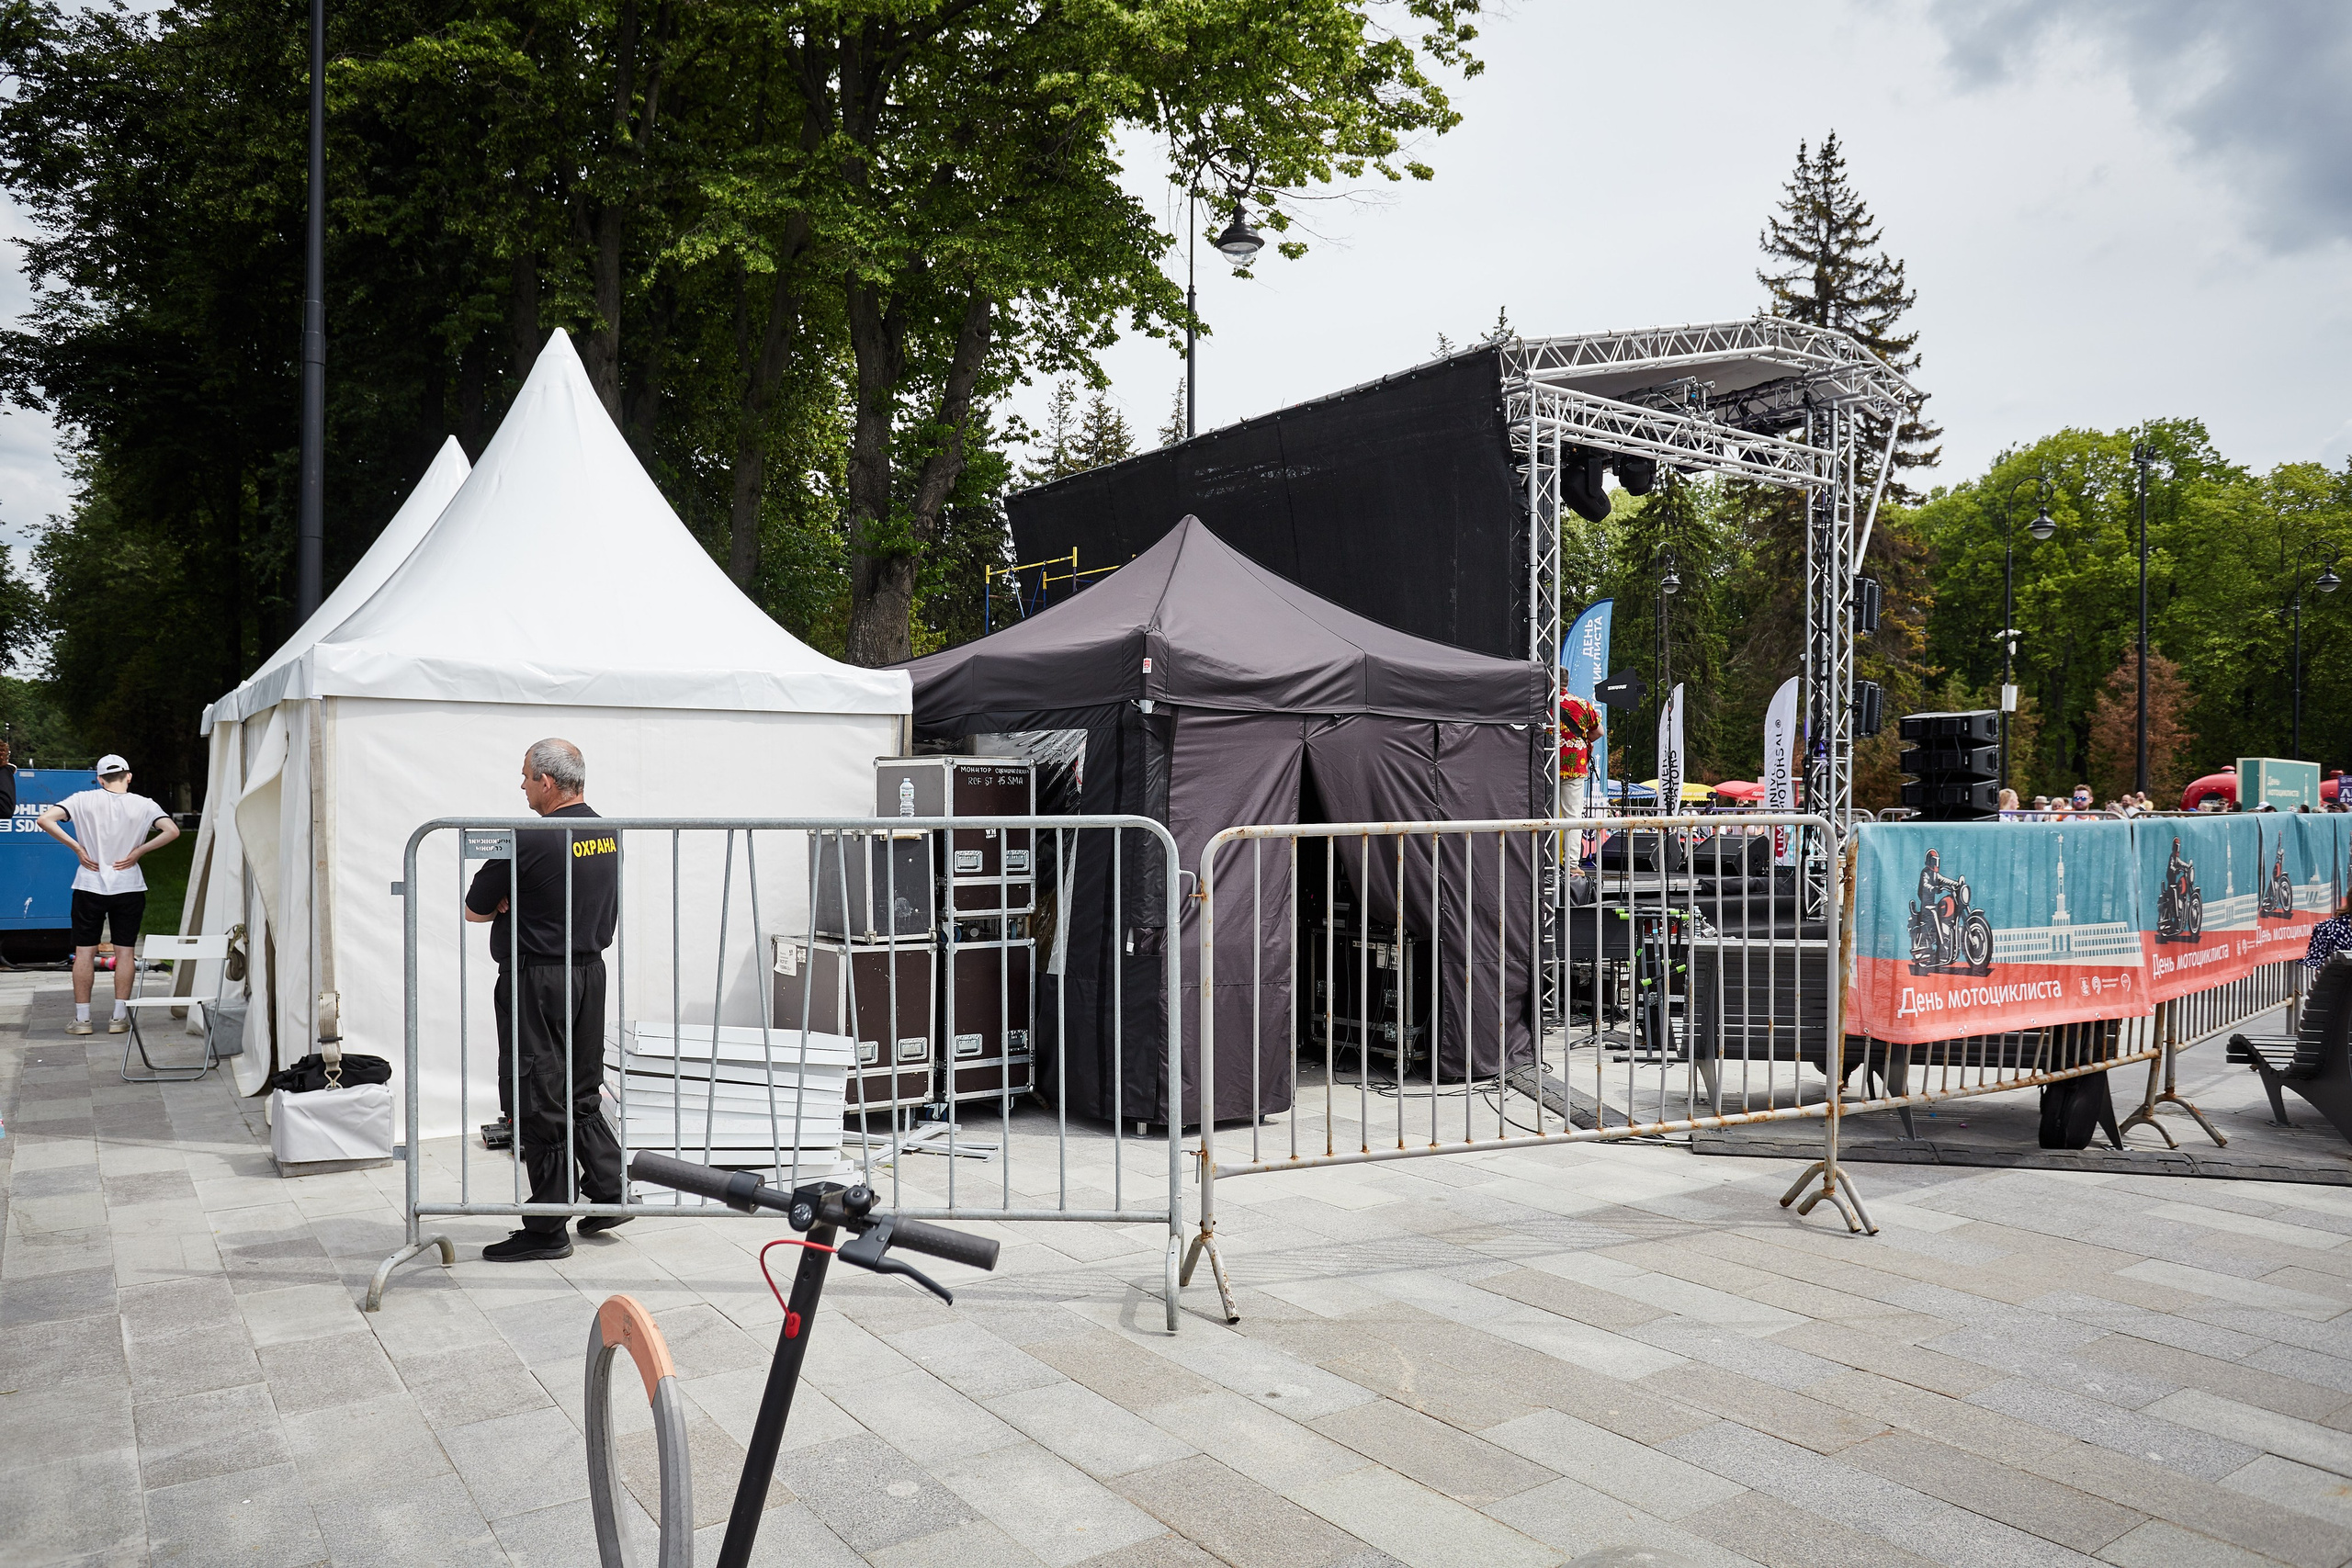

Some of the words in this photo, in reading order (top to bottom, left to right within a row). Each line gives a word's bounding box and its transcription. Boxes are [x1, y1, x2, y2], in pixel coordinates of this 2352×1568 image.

[1583, 619, 1594, 657] ДЕНЬ
[15, 818, 47, 833] SDM
[572, 837, 616, 858] ОХРАНА
[2256, 925, 2272, 948] День
[2273, 923, 2312, 942] мотоцикли
[2152, 953, 2175, 980] День
[2176, 943, 2230, 971] мотоциклиста
[1897, 987, 1944, 1019] День
[1948, 979, 2063, 1009] мотоциклиста
